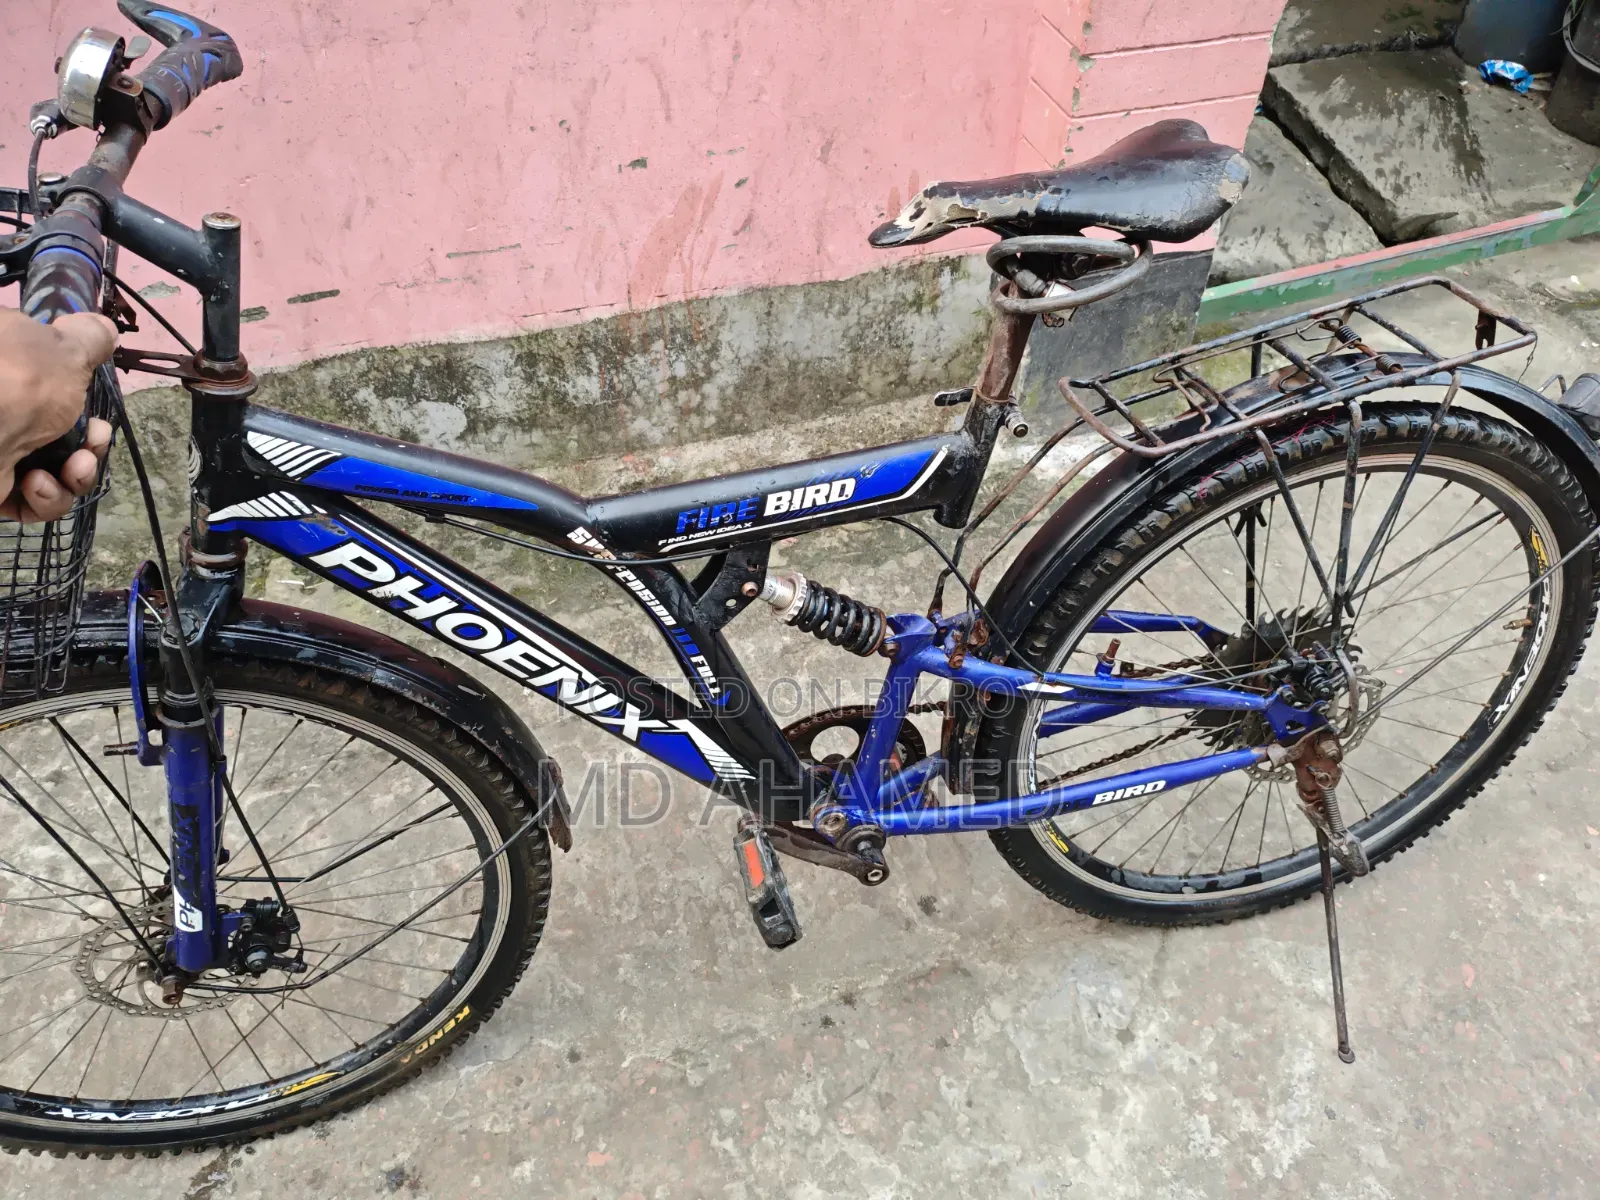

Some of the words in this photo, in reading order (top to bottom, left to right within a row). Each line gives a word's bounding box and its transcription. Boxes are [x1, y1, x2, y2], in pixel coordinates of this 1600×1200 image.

[675, 497, 760, 534] FIRE
[763, 478, 856, 517] BIRD
[657, 535, 688, 546] FIND
[688, 529, 716, 540] NEW
[309, 541, 671, 742] PHOENIX
[1091, 779, 1167, 806] BIRD
